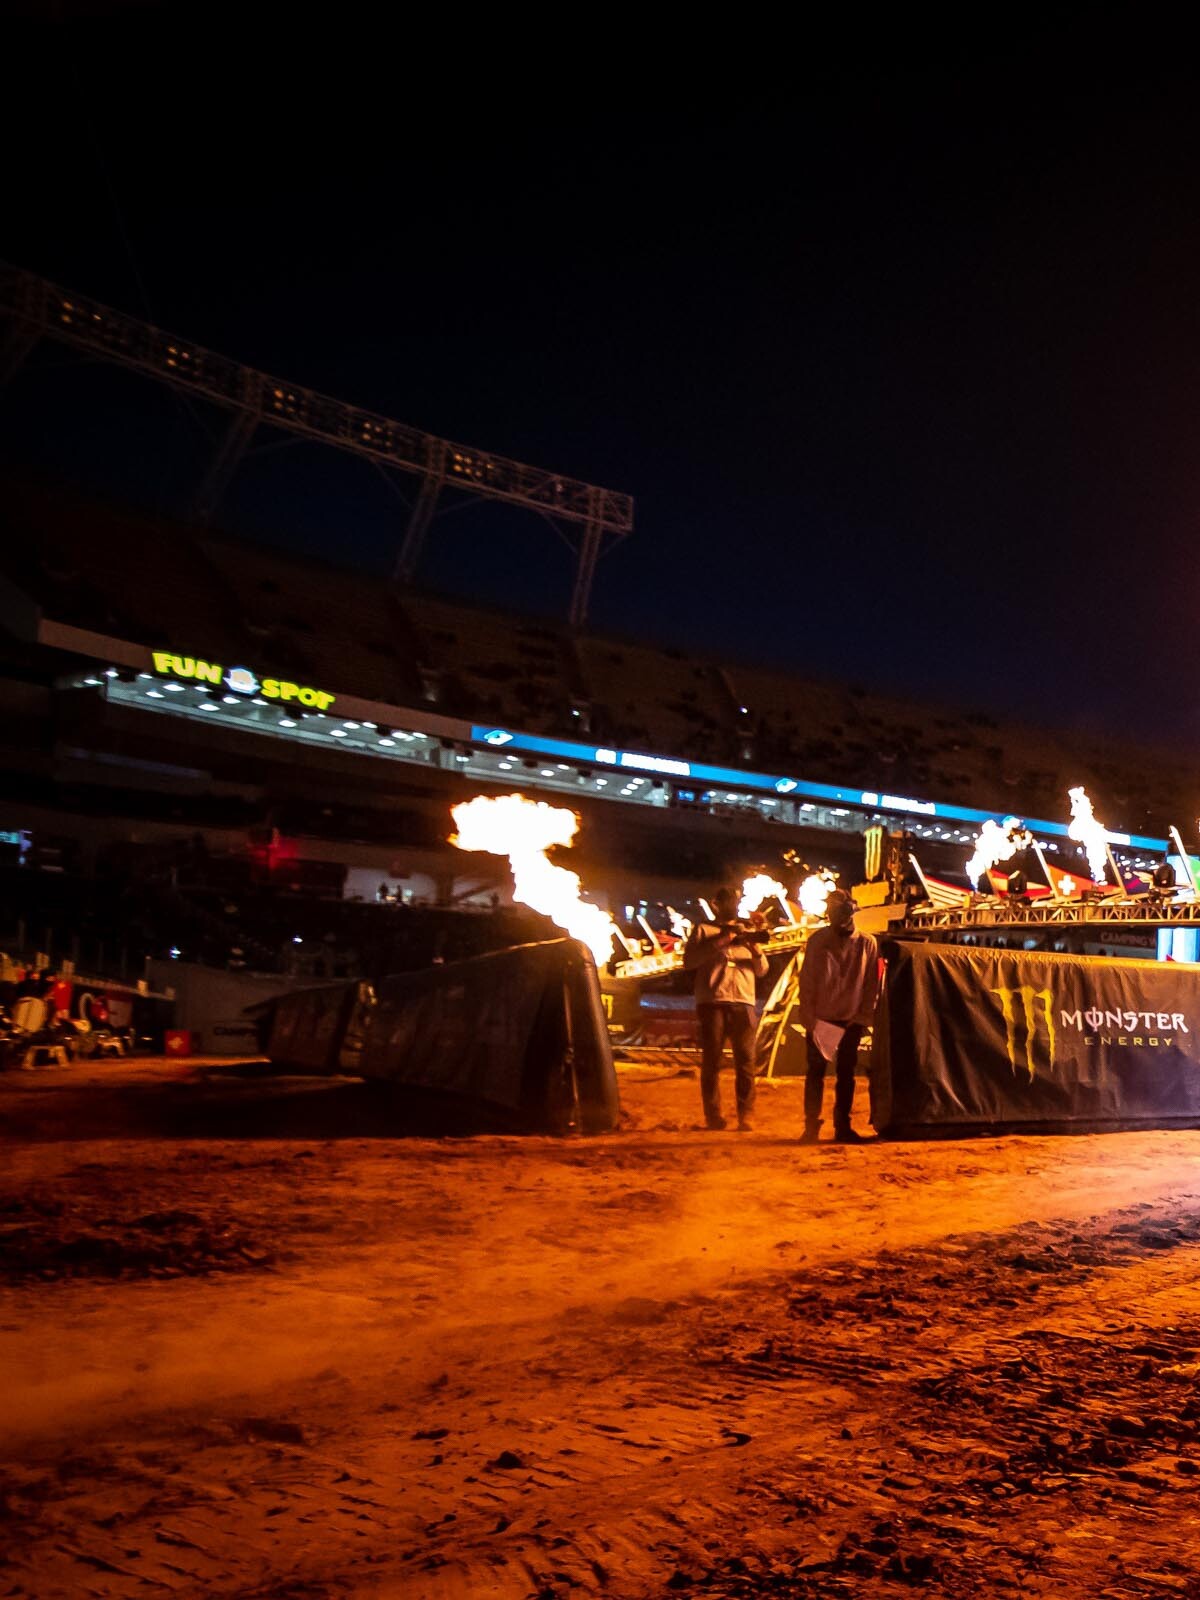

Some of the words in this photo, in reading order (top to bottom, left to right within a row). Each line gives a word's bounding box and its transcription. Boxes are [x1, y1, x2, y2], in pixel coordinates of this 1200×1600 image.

[152, 653, 222, 685] FUN
[261, 679, 335, 710] SPOT
[1060, 1006, 1189, 1033] MONSTER
[1084, 1036, 1173, 1046] ENERGY
